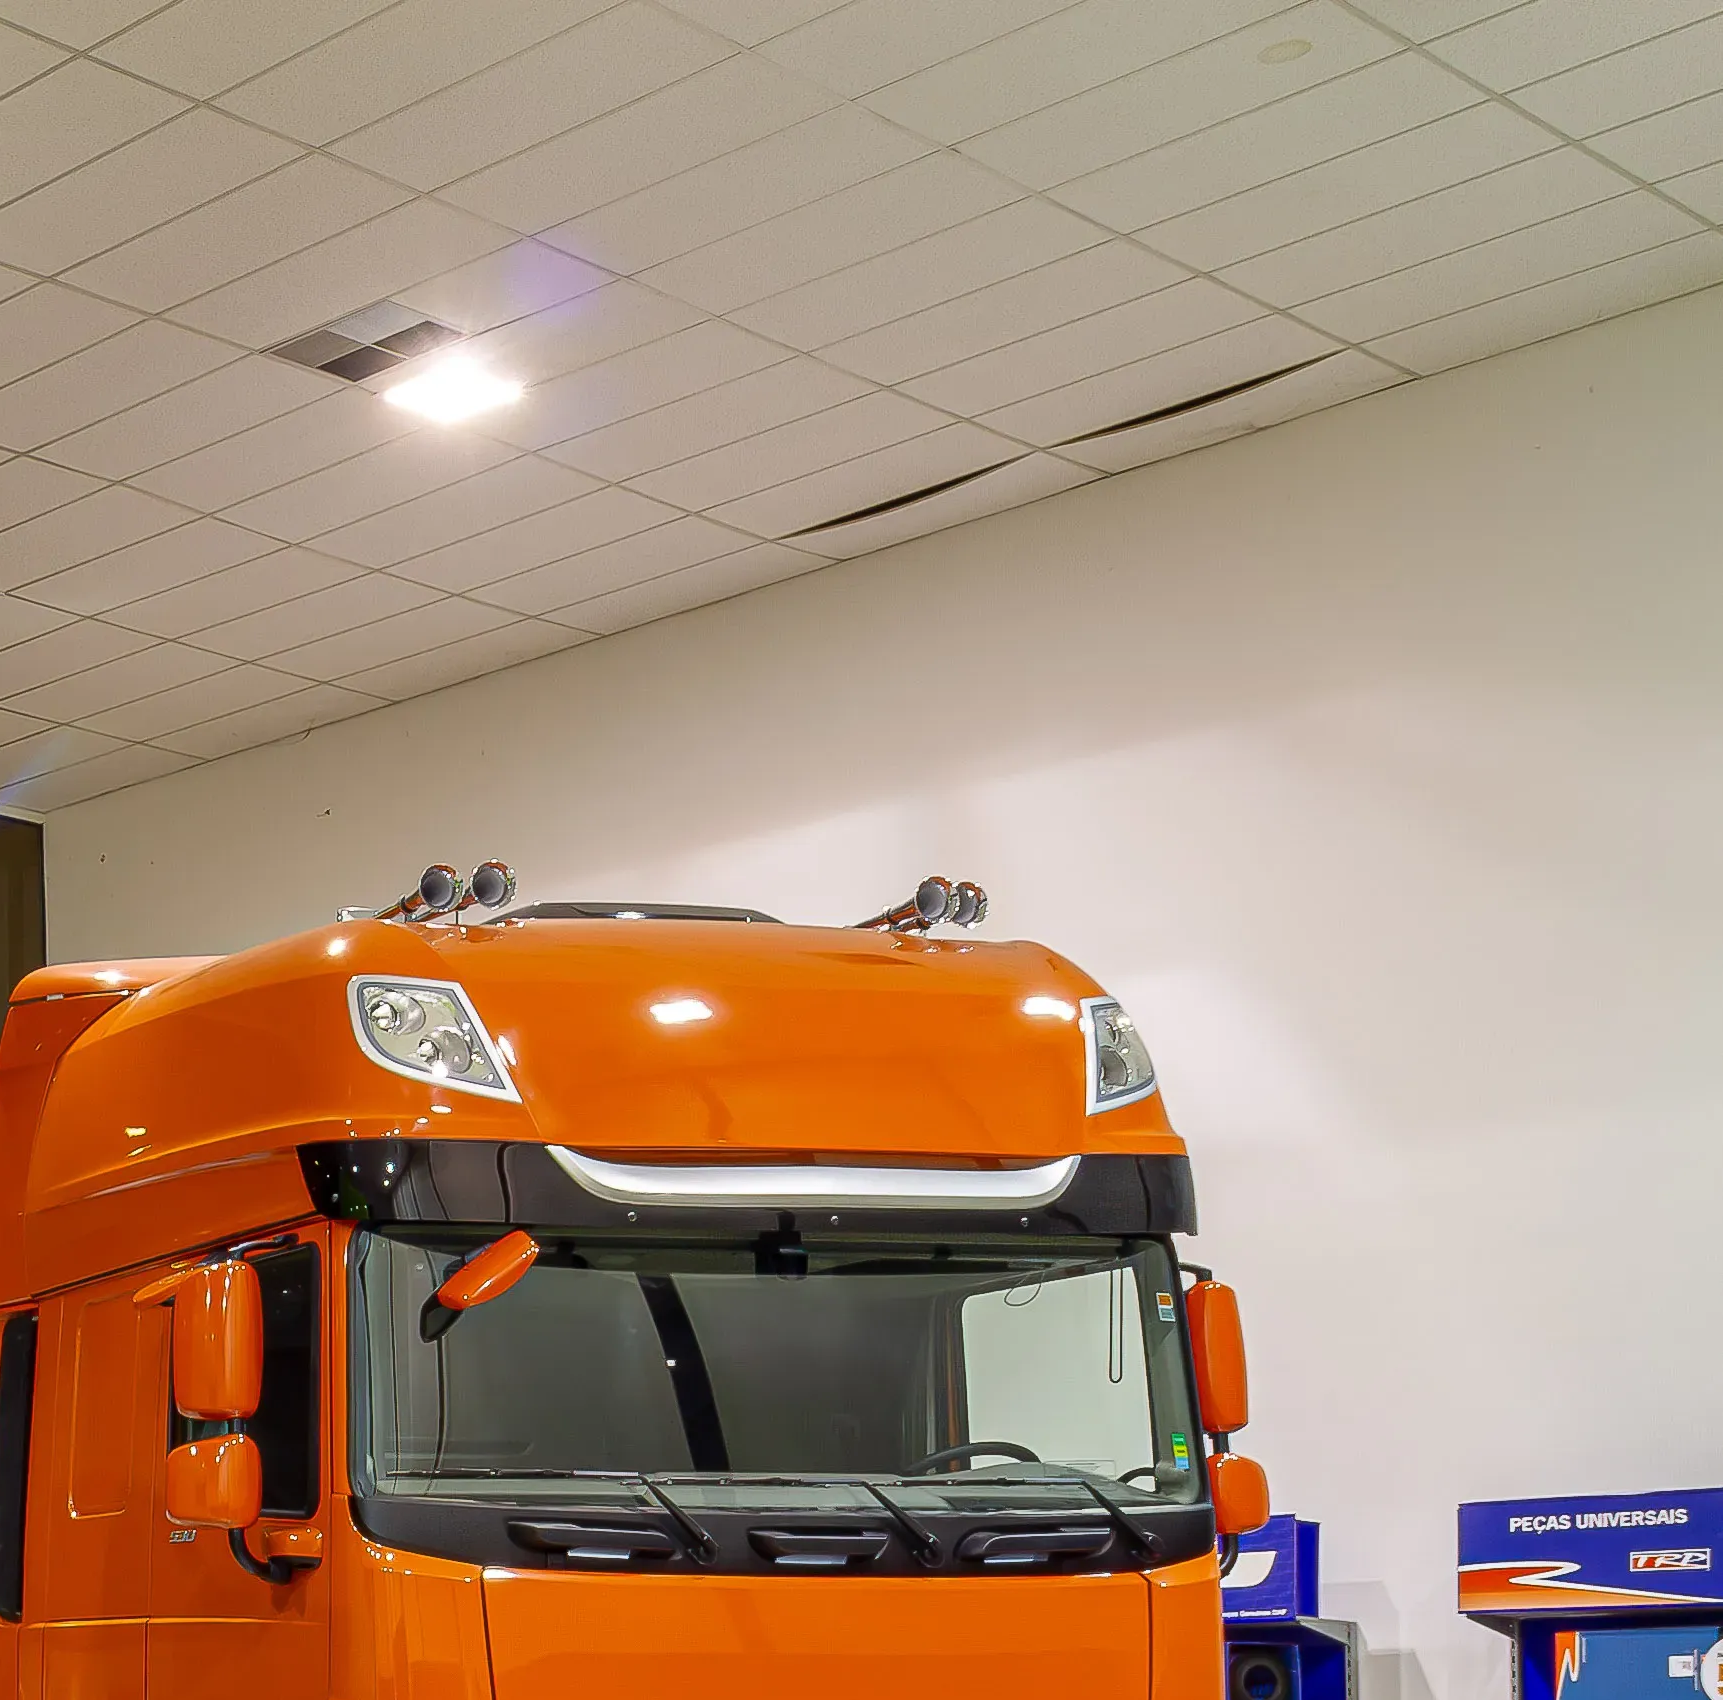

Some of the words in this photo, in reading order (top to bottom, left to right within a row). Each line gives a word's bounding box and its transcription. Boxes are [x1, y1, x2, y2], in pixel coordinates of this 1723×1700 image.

[1510, 1515, 1571, 1534] PEÇAS
[1576, 1508, 1689, 1529] UNIVERSAIS
[1633, 1552, 1709, 1568] TRP
